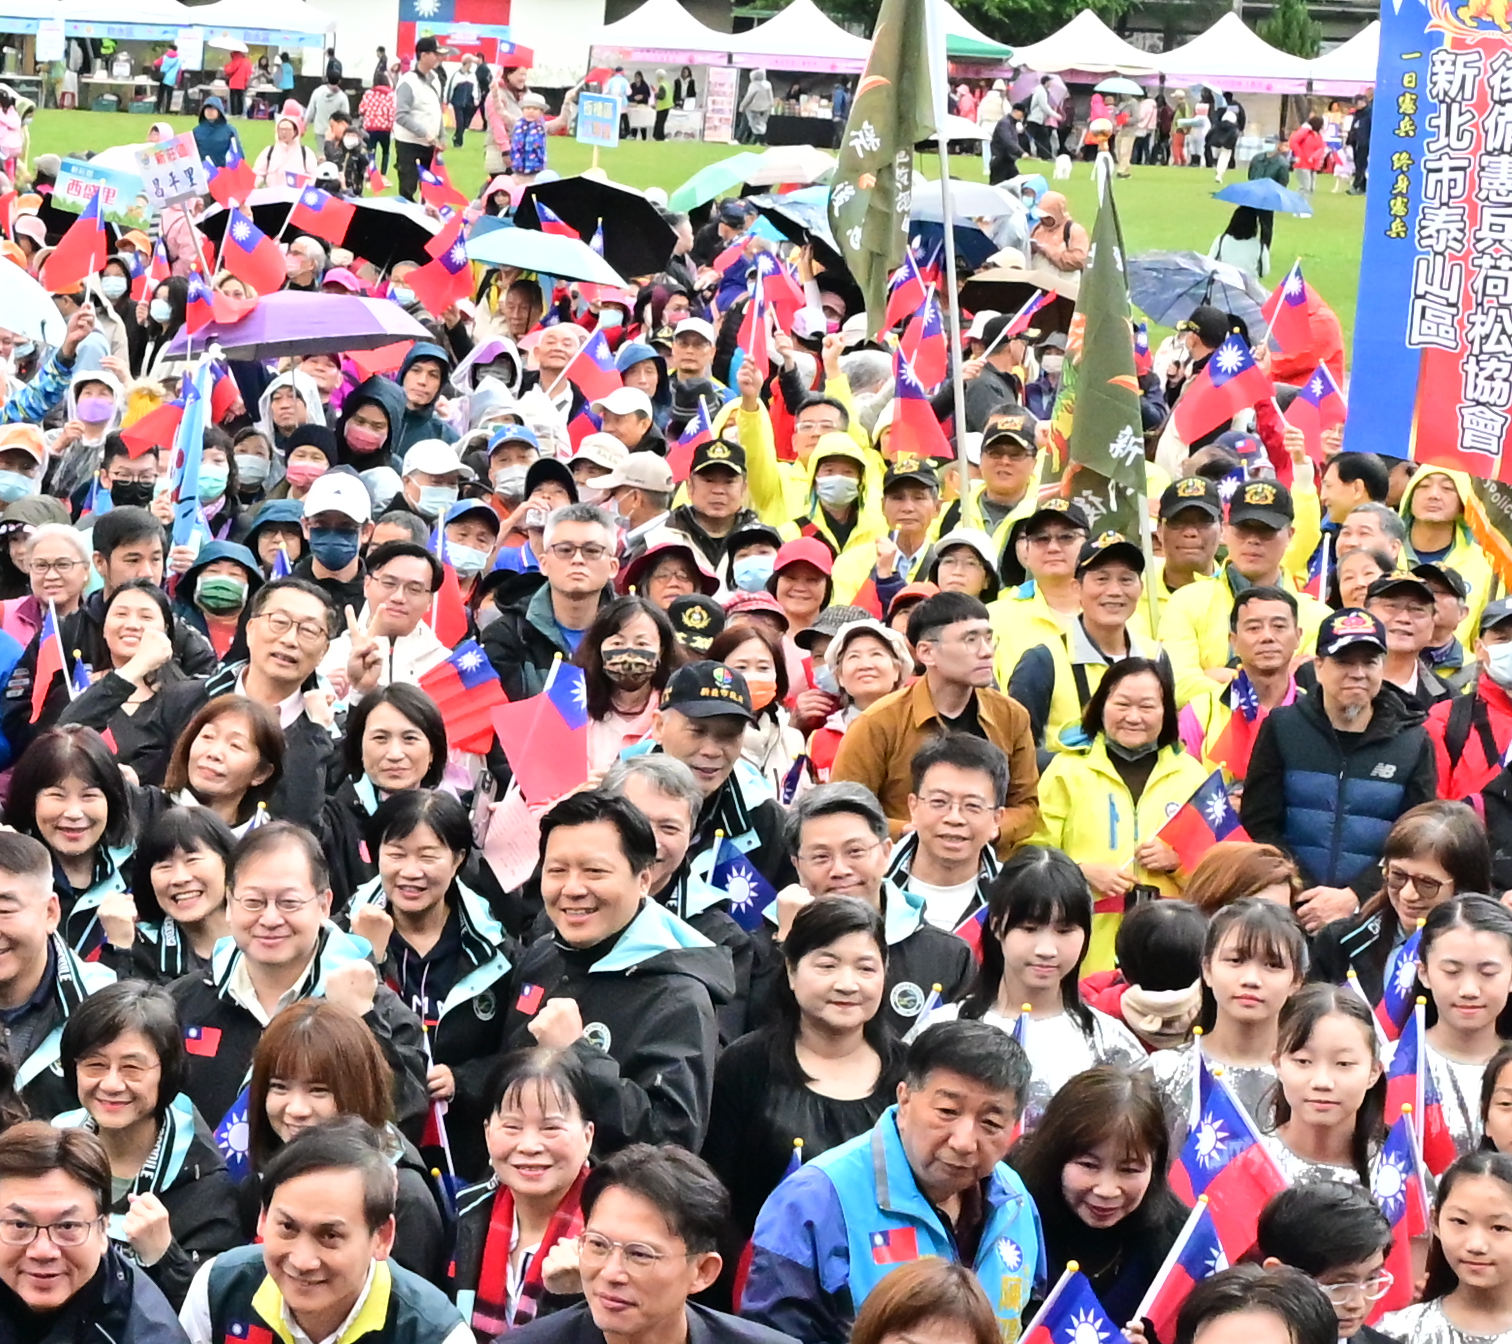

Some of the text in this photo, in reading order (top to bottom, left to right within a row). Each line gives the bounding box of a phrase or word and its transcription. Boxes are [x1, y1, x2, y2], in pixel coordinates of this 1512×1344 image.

[1407, 49, 1481, 348] 新北市泰山區
